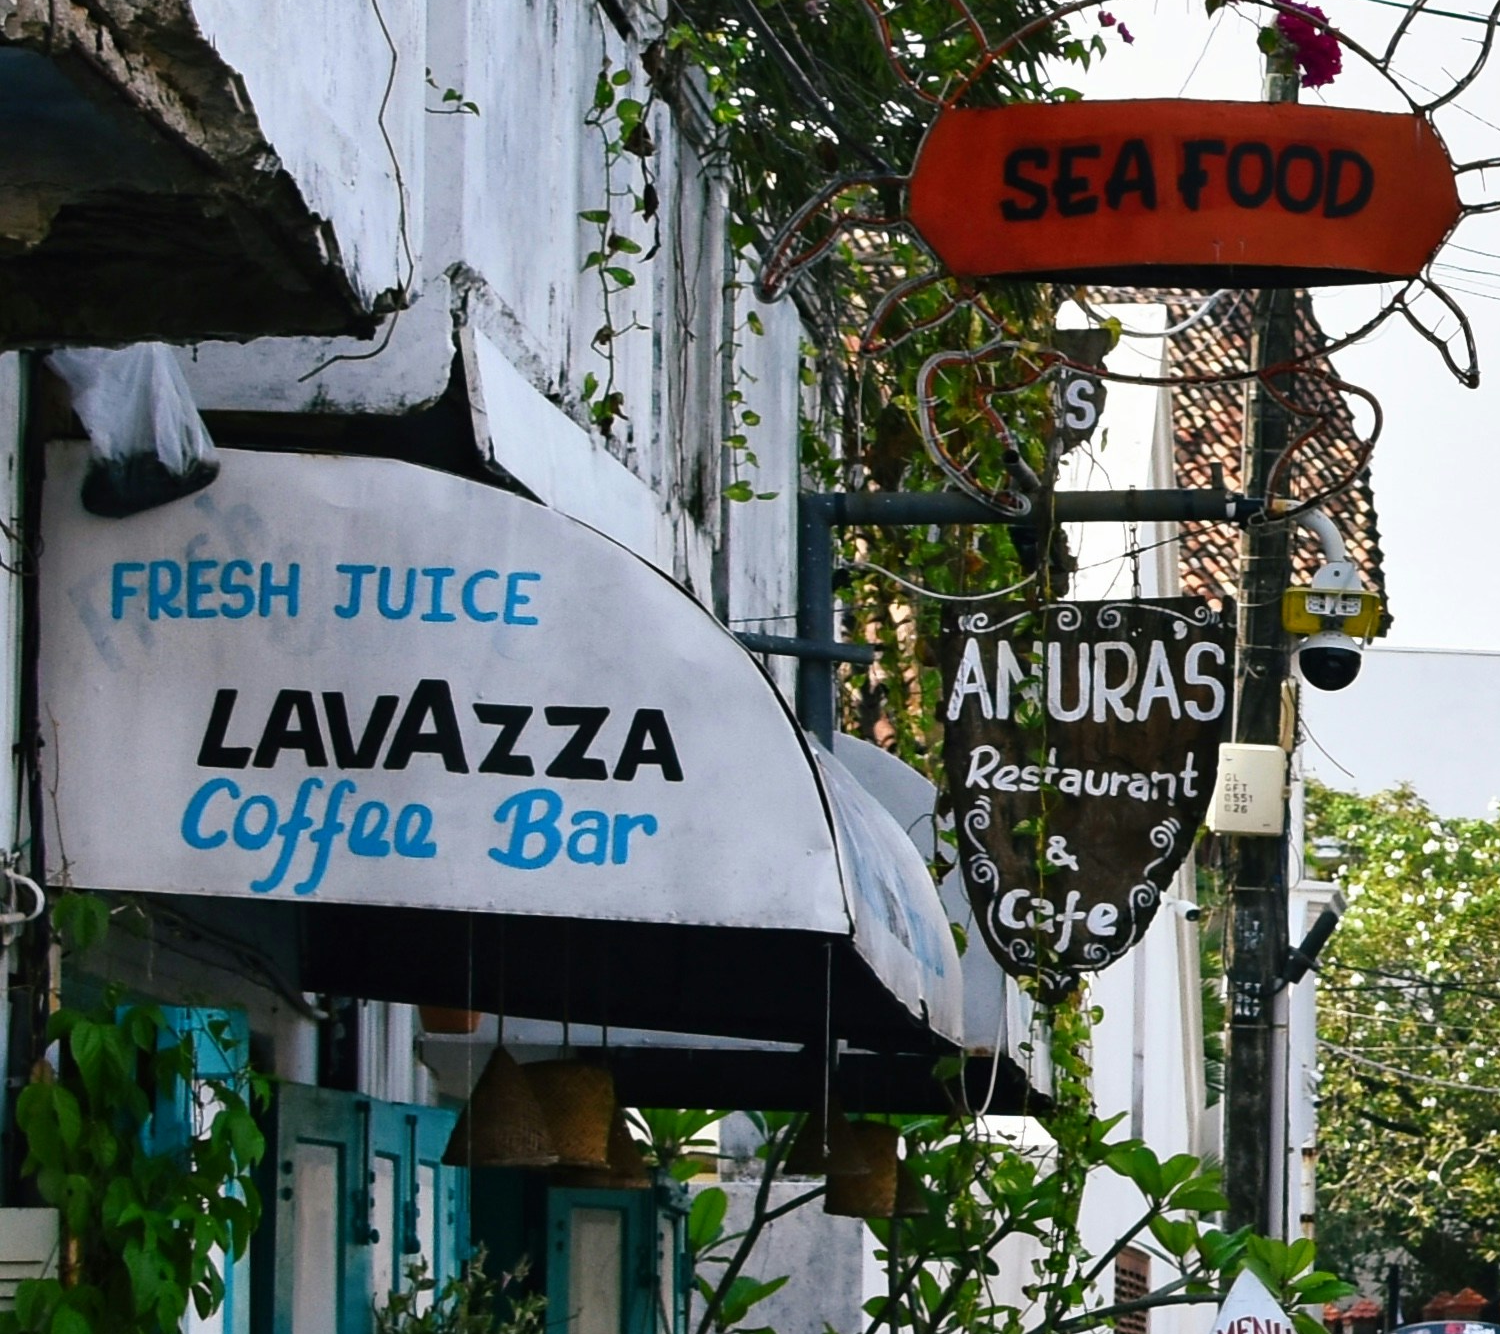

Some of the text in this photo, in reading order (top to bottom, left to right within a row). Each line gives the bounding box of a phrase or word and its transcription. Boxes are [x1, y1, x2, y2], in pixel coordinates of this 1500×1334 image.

[1002, 138, 1375, 222] SEA FOOD
[111, 560, 541, 625] FRESH JUICE
[197, 679, 684, 782] LAVAZZA
[966, 745, 1199, 802] Restaurant
[181, 778, 658, 895] Coffee Bar
[1046, 835, 1080, 871] &
[998, 889, 1119, 954] Cafe
